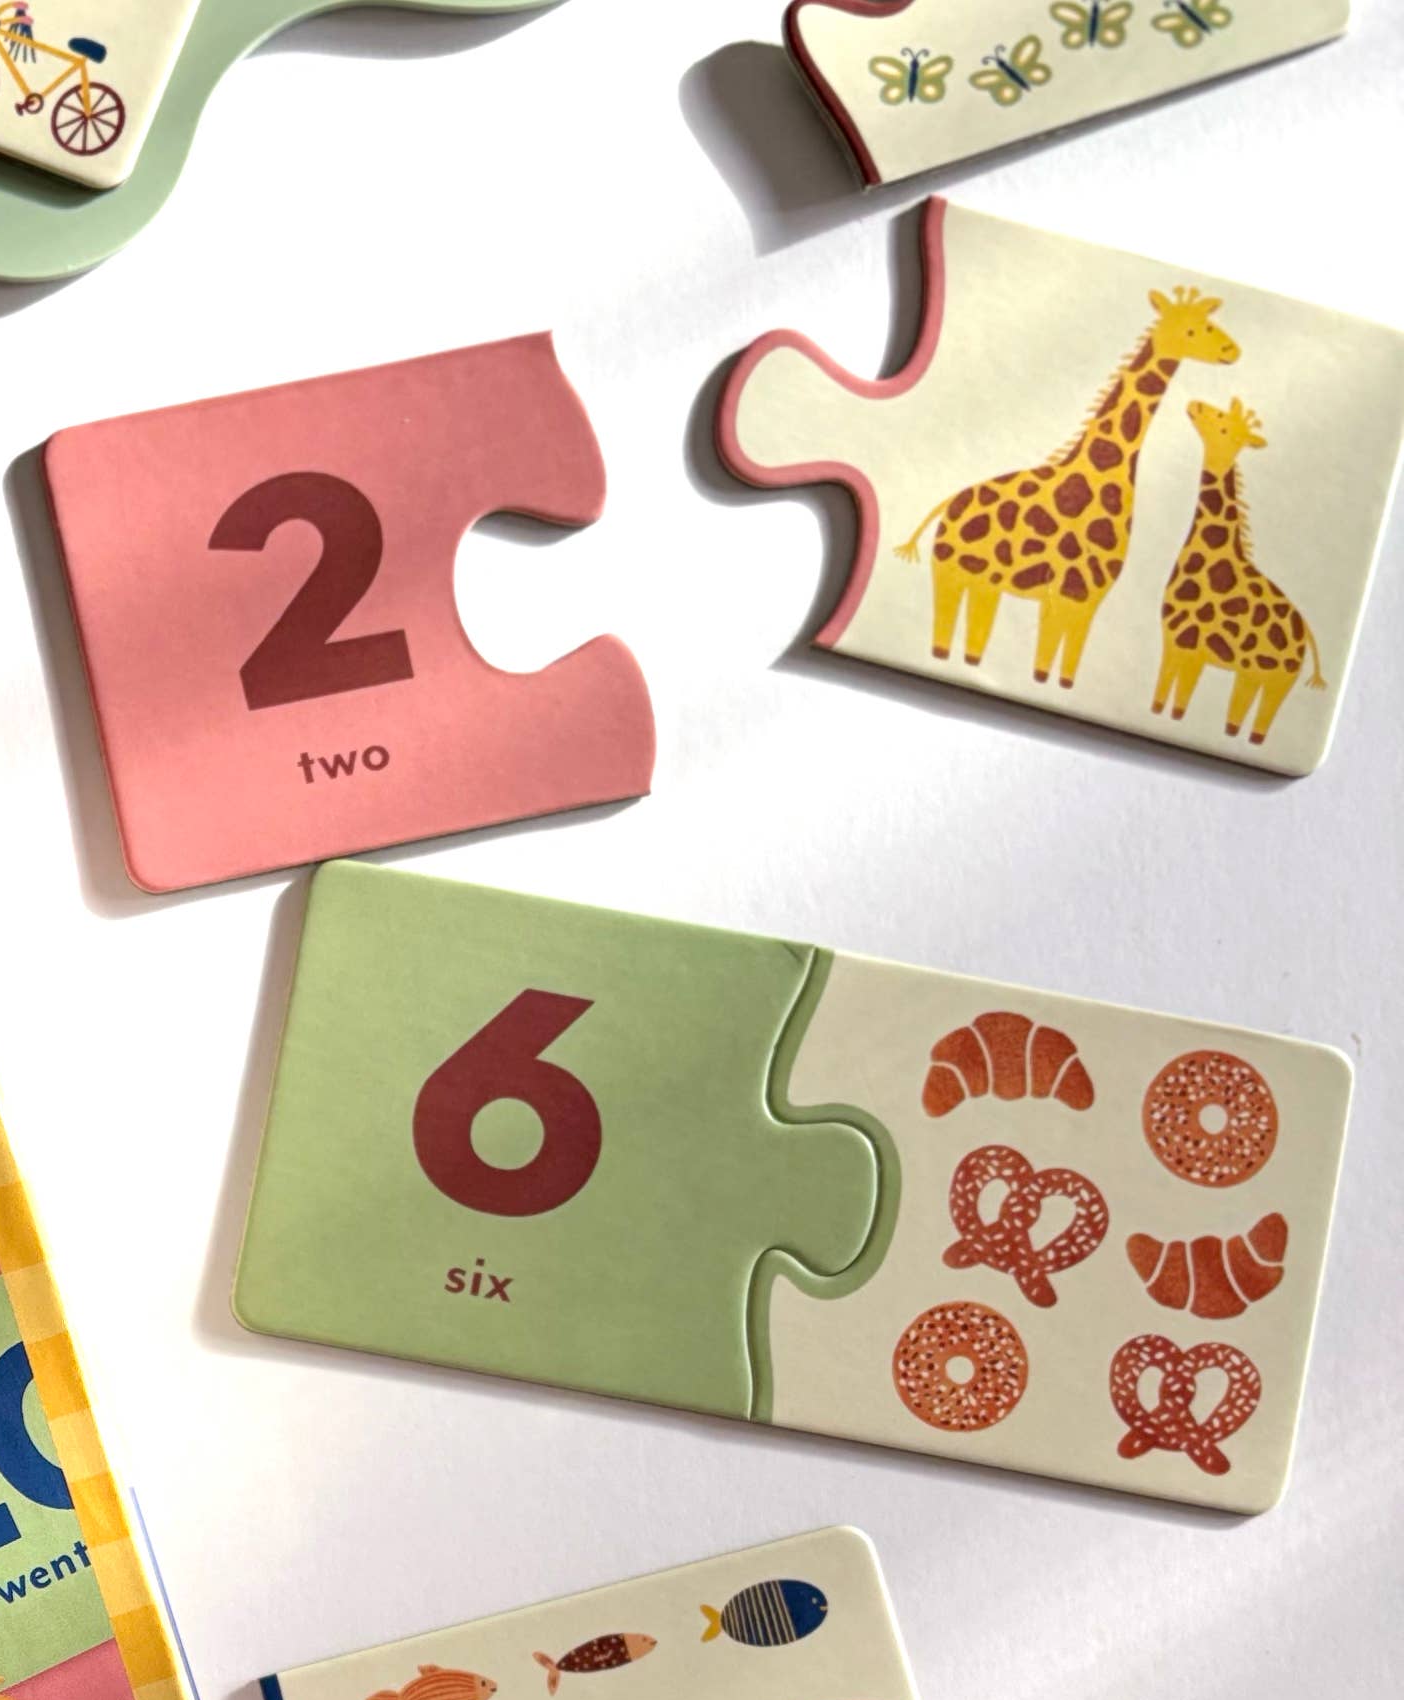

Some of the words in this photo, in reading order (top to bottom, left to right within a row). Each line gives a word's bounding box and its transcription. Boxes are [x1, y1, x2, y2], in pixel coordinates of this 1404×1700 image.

[209, 471, 415, 711] 2
[297, 745, 391, 785] two
[412, 987, 605, 1218] 6
[442, 1256, 513, 1304] six
